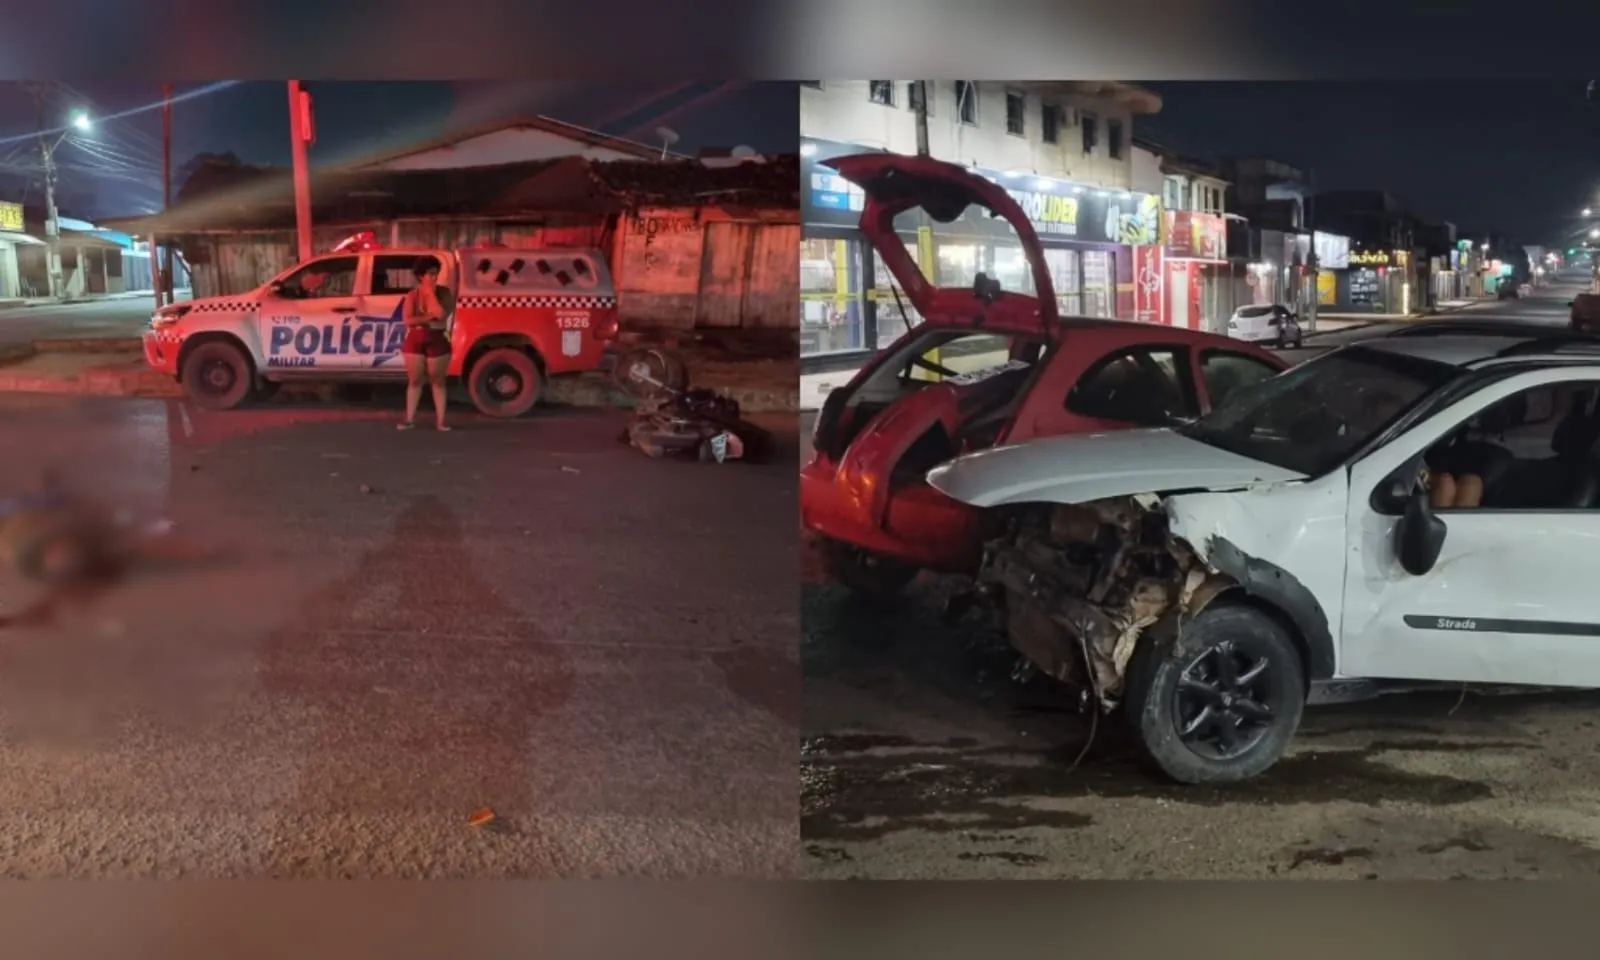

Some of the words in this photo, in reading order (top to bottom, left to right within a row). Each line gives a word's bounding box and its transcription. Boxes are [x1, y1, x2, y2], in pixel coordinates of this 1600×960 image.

[555, 317, 590, 328] 1526
[270, 317, 407, 355] POLÍCIA
[267, 356, 316, 367] MILITAR
[1436, 618, 1477, 629] Strada
